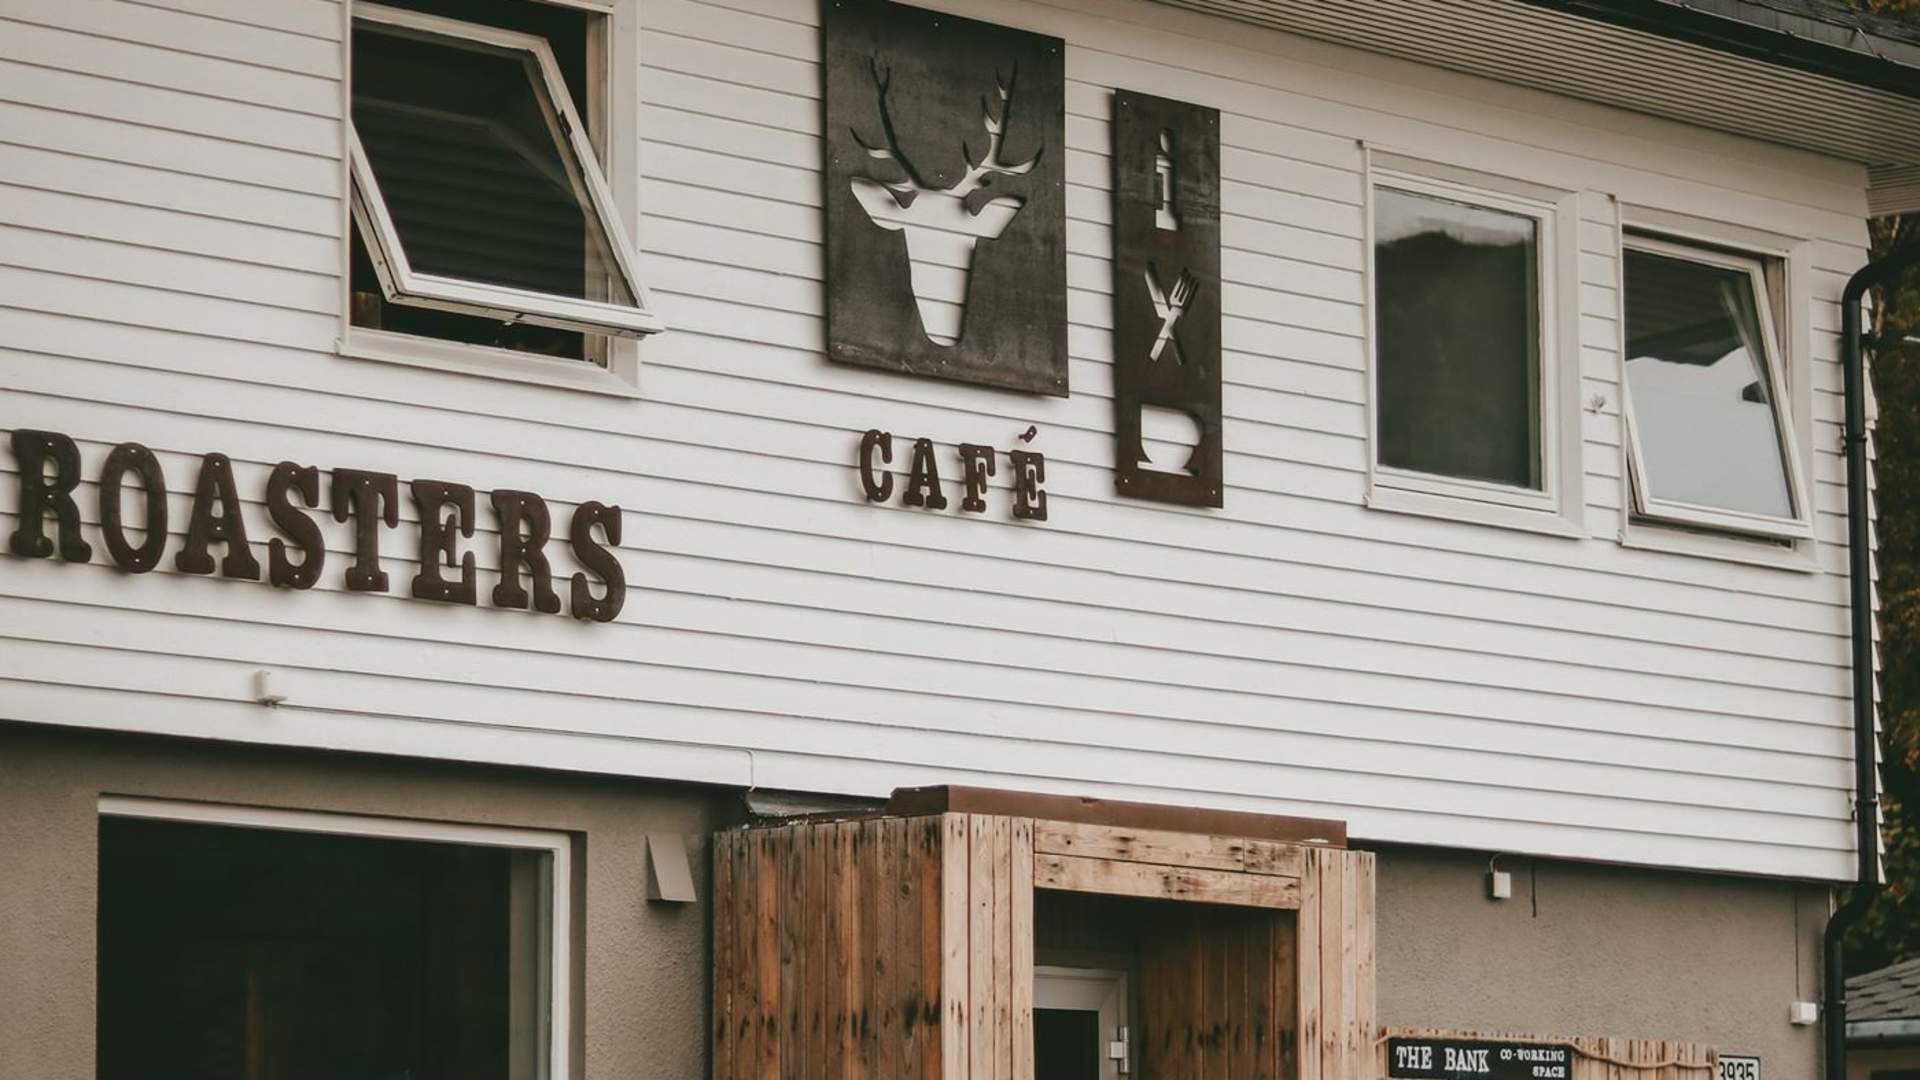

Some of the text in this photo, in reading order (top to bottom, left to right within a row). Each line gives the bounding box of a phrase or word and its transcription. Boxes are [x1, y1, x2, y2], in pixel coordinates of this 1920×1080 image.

[860, 425, 1048, 521] CAFÉ
[10, 428, 627, 622] ROASTERS
[1396, 1045, 1490, 1072] THE BANK
[1500, 1049, 1565, 1062] CO-WORKING
[1532, 1066, 1565, 1078] SPACE
